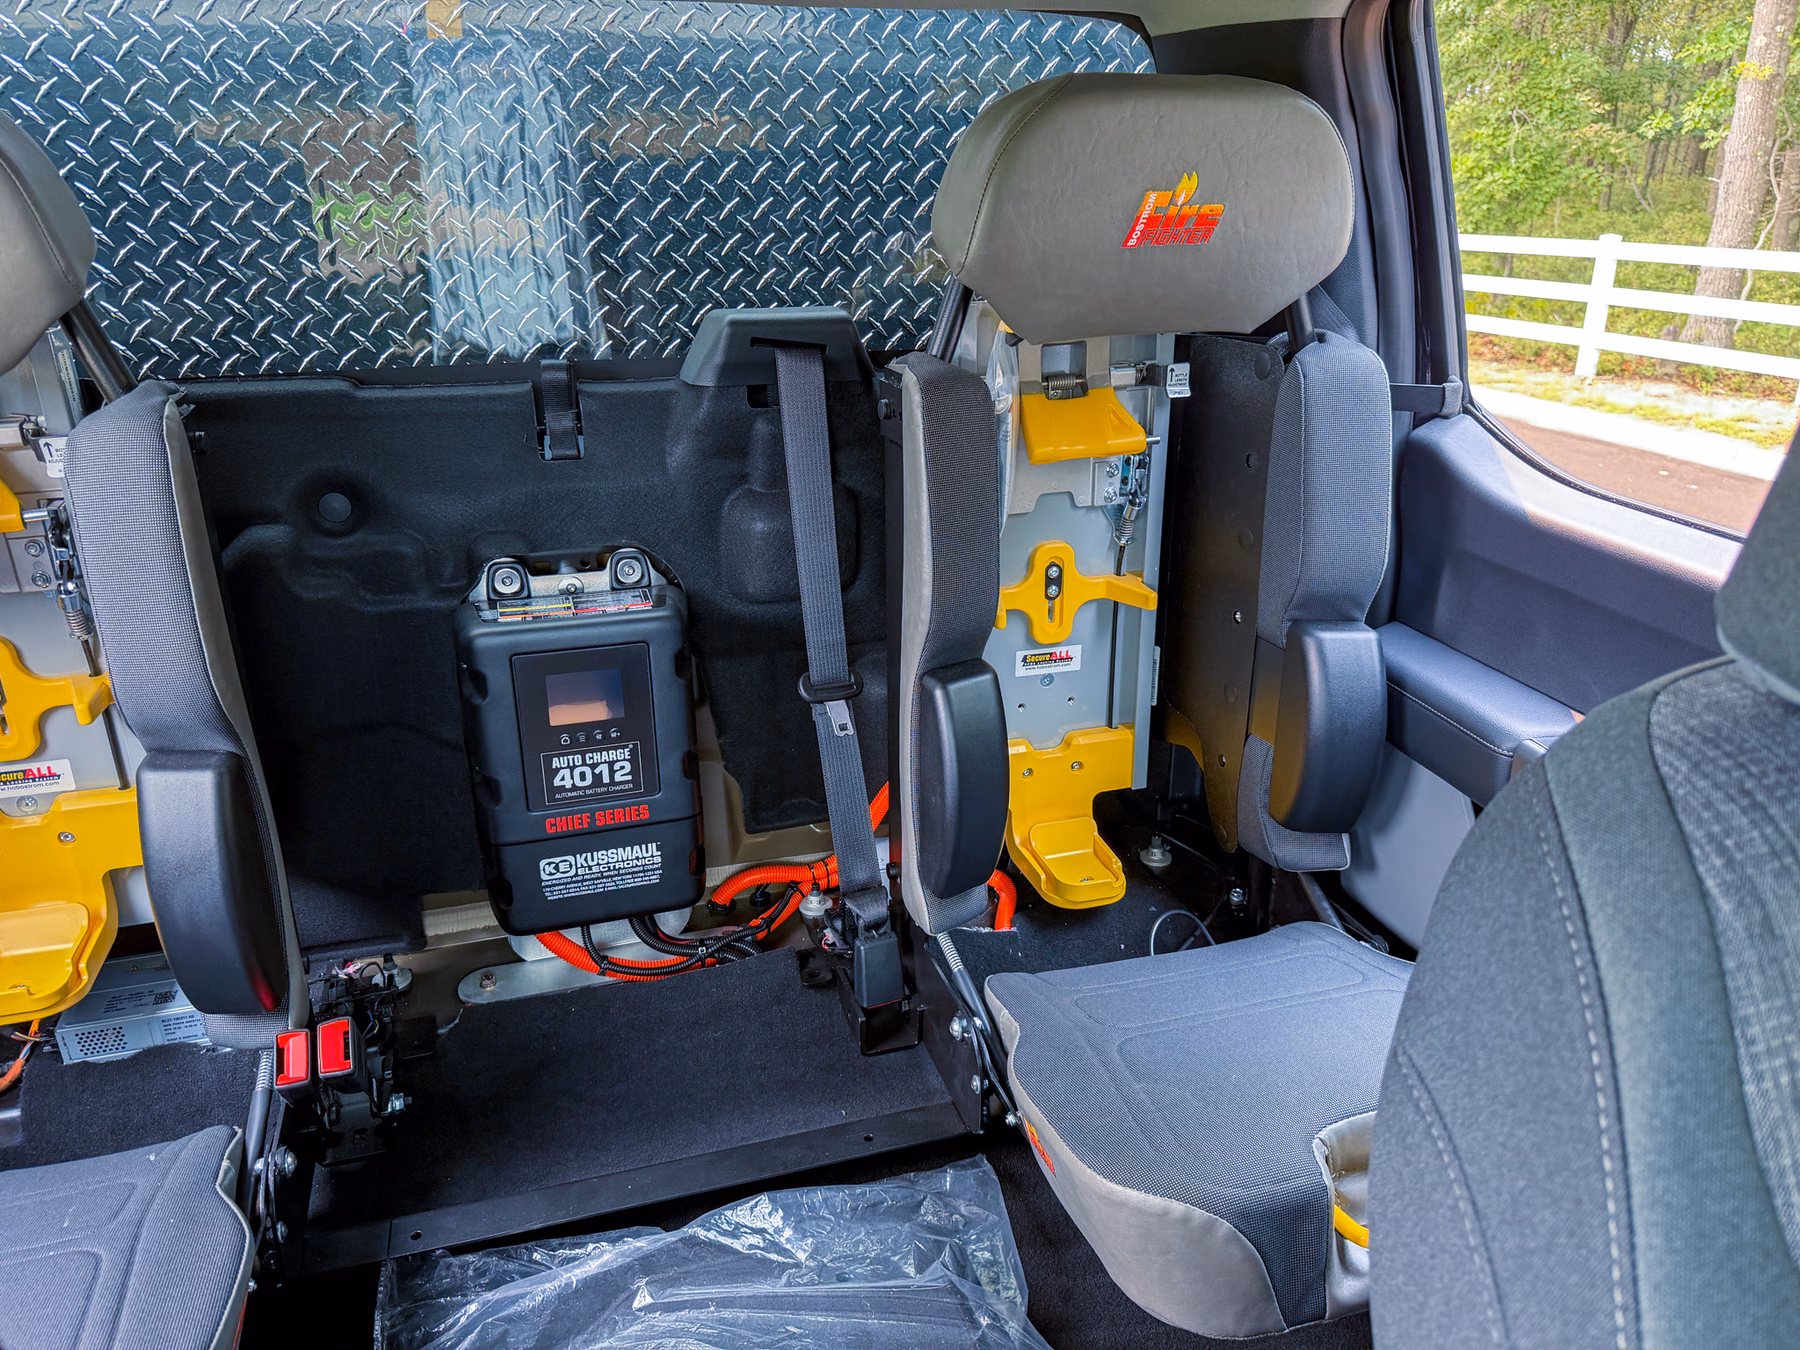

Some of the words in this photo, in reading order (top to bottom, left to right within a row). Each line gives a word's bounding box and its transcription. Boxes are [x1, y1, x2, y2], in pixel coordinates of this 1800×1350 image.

[1141, 190, 1225, 229] Fire
[1126, 193, 1157, 246] BOSTROM
[1140, 228, 1215, 247] FIGHTER
[1026, 650, 1073, 662] SecureALL
[552, 754, 582, 769] AUTO
[0, 766, 57, 782] cureALL
[553, 760, 632, 789] 4012
[555, 789, 585, 799] AUTOMATIC
[586, 786, 608, 796] BATTERY
[609, 783, 634, 792] CHARGER
[546, 813, 591, 834] CHIEF
[596, 804, 650, 826] SERIES
[576, 842, 662, 868] KUSSMAUL
[578, 856, 662, 875] ELECTRONICS
[542, 878, 572, 886] ENERGIZED
[620, 866, 644, 874] SECONDS
